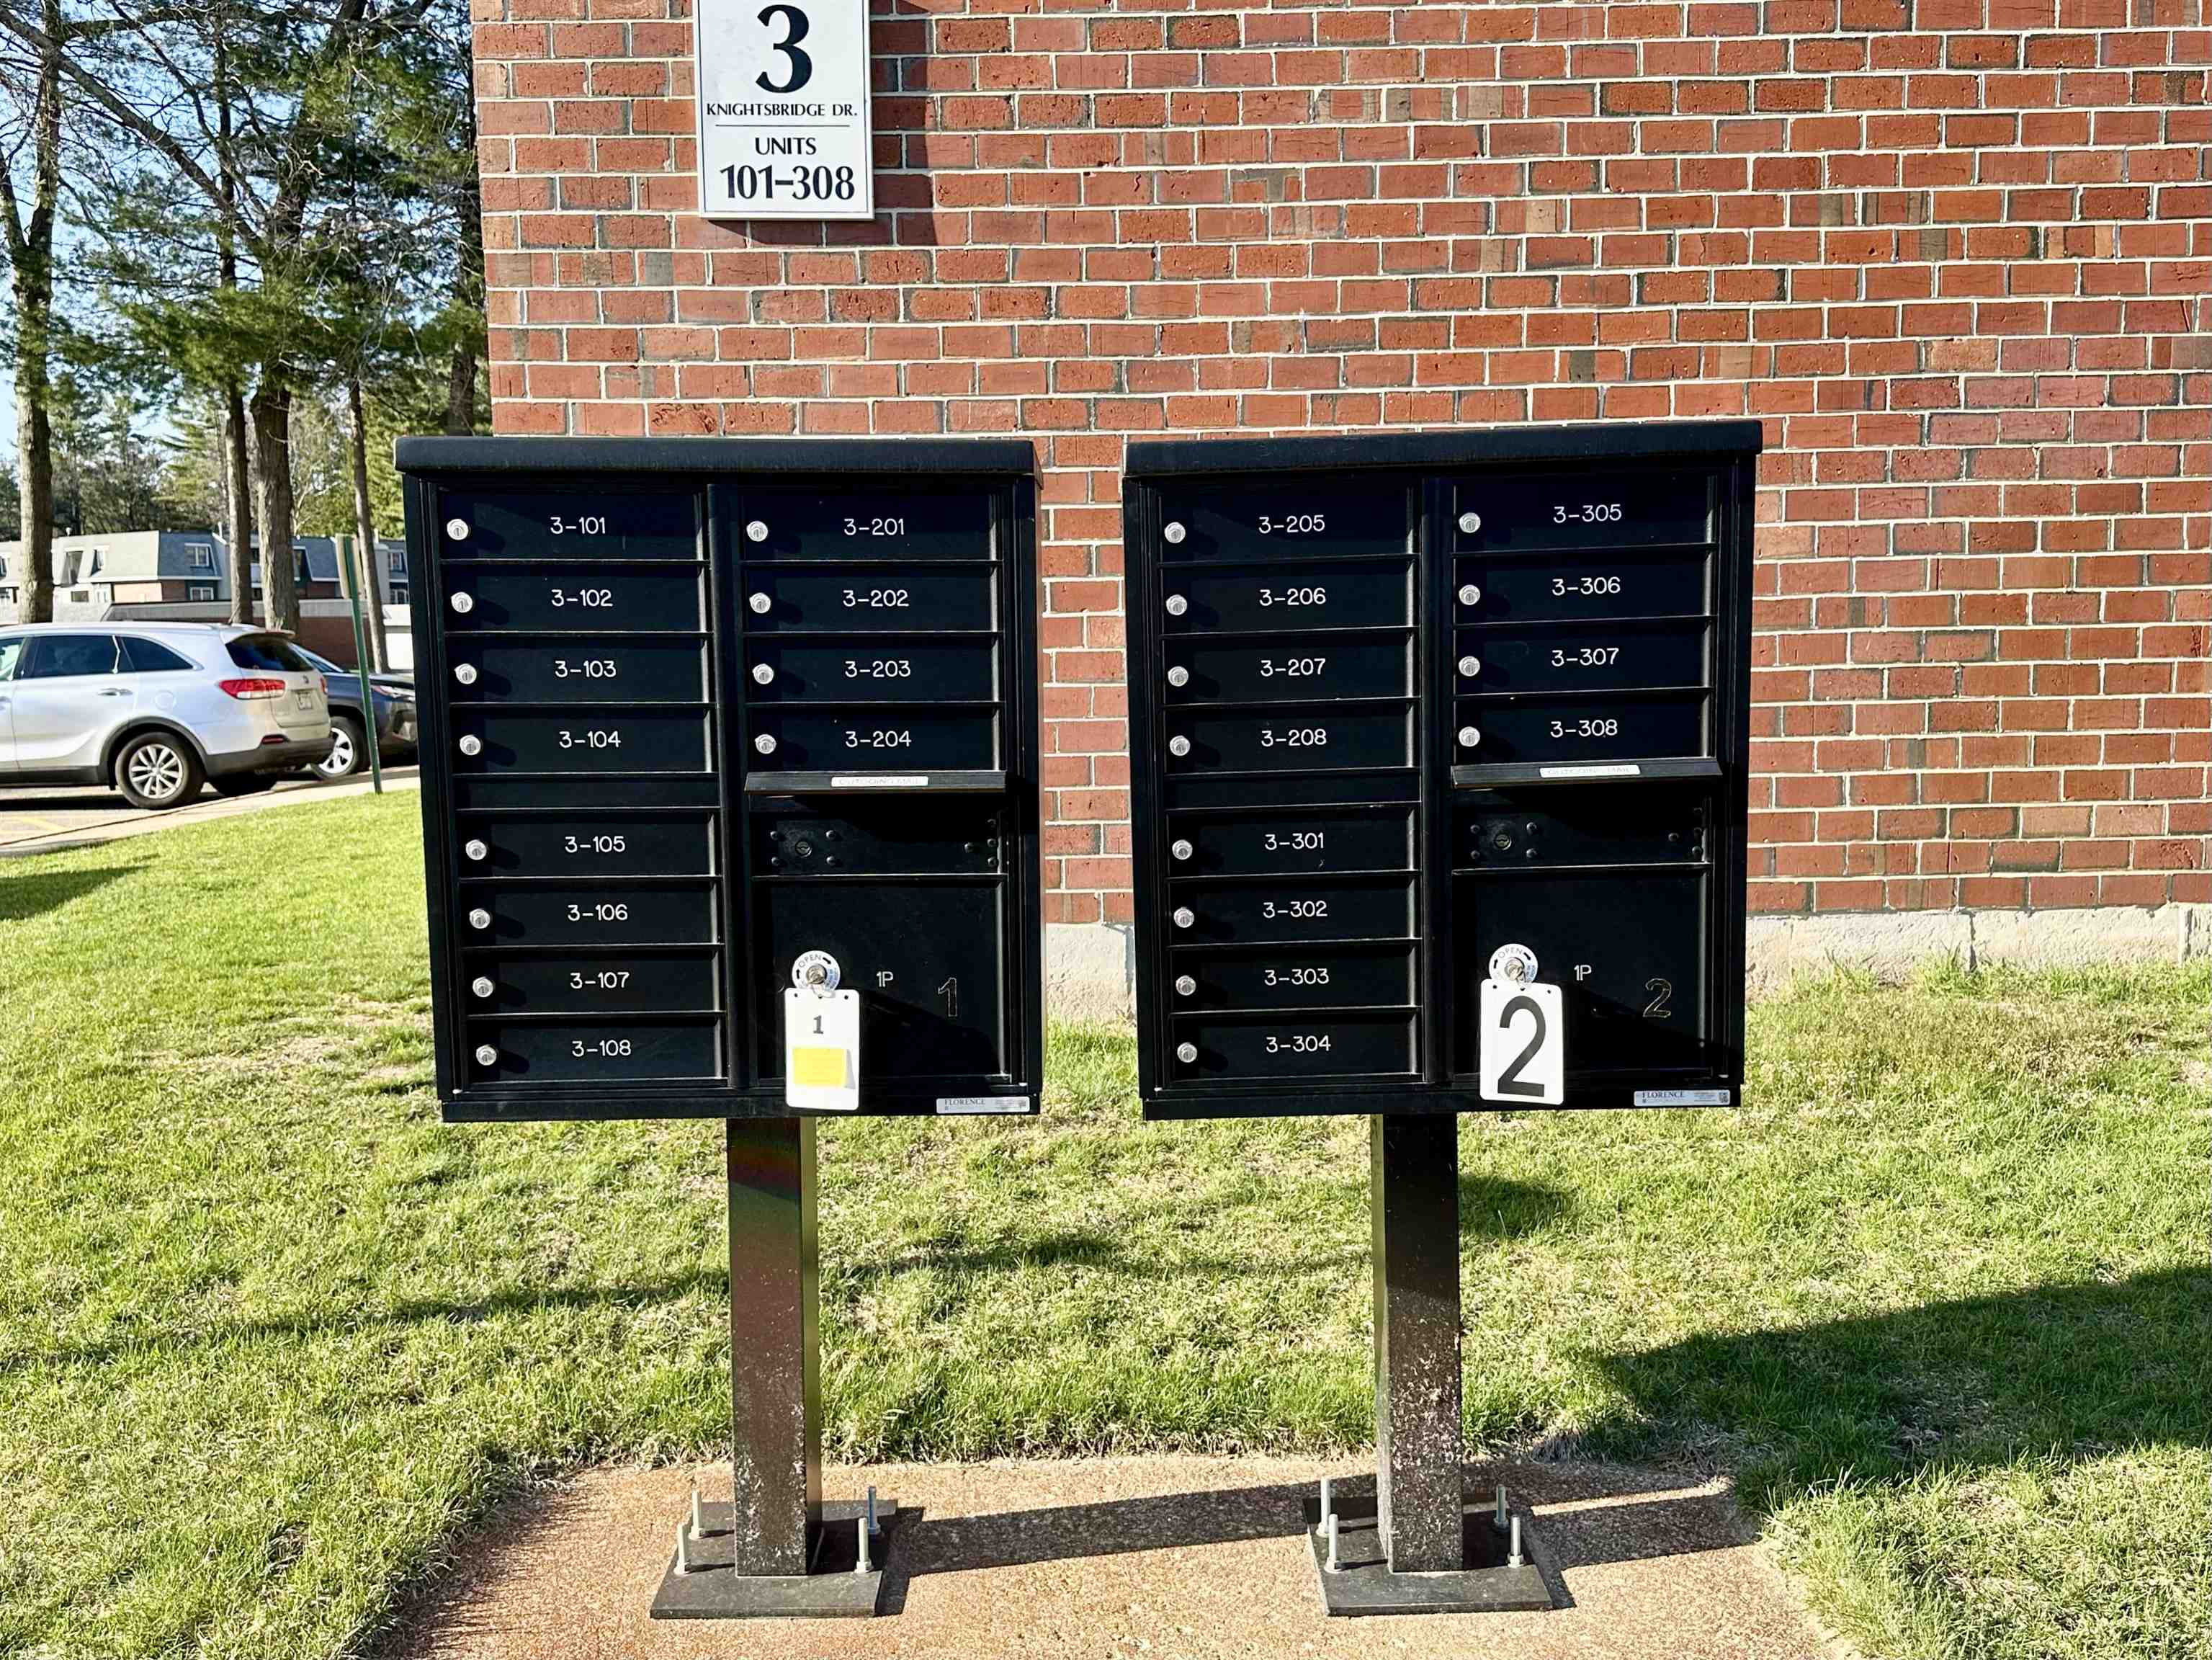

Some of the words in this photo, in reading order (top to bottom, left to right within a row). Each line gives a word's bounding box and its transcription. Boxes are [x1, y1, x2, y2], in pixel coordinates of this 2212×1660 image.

[756, 4, 812, 94] 3
[707, 102, 825, 117] KNIGHTSBRIDGE
[832, 103, 858, 117] DR.
[755, 137, 817, 156] UNITS
[720, 164, 855, 200] 101-308
[1553, 504, 1622, 524] 3-305
[550, 517, 606, 535] 3-101
[843, 518, 905, 536] 3-201
[1258, 514, 1325, 534] 3-205
[1551, 576, 1621, 597] 3-306
[551, 589, 614, 607] 3-102
[843, 589, 910, 607] 3-202
[1259, 587, 1327, 607] 3-206
[1551, 647, 1619, 667] 3-307
[555, 660, 617, 678] 3-103
[845, 660, 911, 678] 3-203
[1260, 658, 1326, 677] 3-207
[1261, 728, 1327, 747] 3-208
[1550, 718, 1618, 738] 3-308
[559, 731, 622, 749] 3-104
[845, 730, 912, 749] 3-204
[565, 835, 626, 853] 3-105
[1264, 831, 1324, 851] 3-301
[567, 903, 628, 922] 3-106
[1263, 900, 1328, 919] 3-302
[798, 953, 822, 968] OPEN
[1497, 947, 1523, 958] OPEN
[570, 971, 630, 989] 3-107
[876, 970, 894, 988] 1P
[1264, 968, 1330, 986] 3-303
[1574, 964, 1592, 981] 1P
[937, 977, 958, 1017] 1
[1642, 977, 1672, 1019] 2
[812, 1014, 825, 1035] 1
[572, 1039, 632, 1058] 3-108
[1266, 1035, 1332, 1053] 3-304
[1497, 995, 1546, 1098] 2
[1642, 1090, 1684, 1099] FLORENCE
